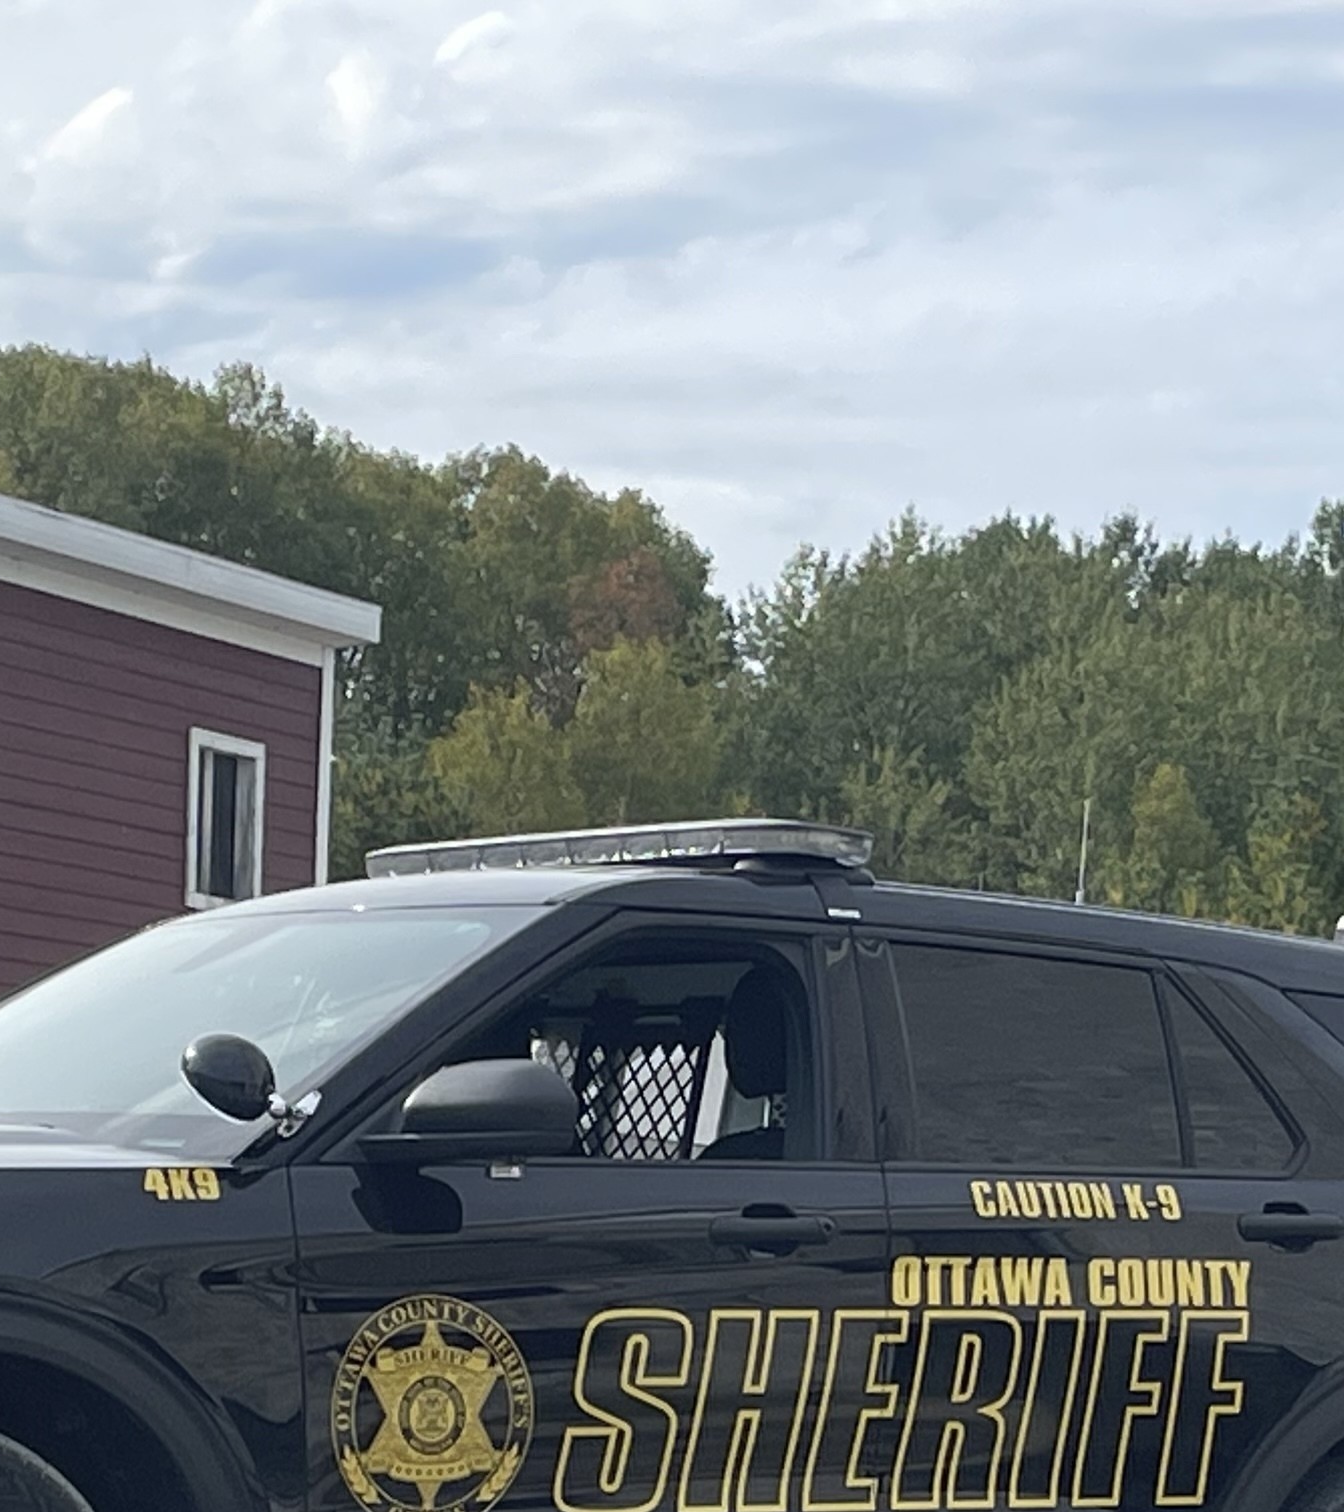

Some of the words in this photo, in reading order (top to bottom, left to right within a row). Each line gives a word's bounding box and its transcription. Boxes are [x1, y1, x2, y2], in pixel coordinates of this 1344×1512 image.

[144, 1168, 221, 1200] 4K9
[970, 1180, 1117, 1220] CAUTION
[1122, 1183, 1182, 1221] K-9
[891, 1255, 1073, 1307] OTTAWA
[1087, 1257, 1252, 1307] COUNTY
[336, 1330, 379, 1431] OTTAWA
[377, 1299, 473, 1335] COUNTY
